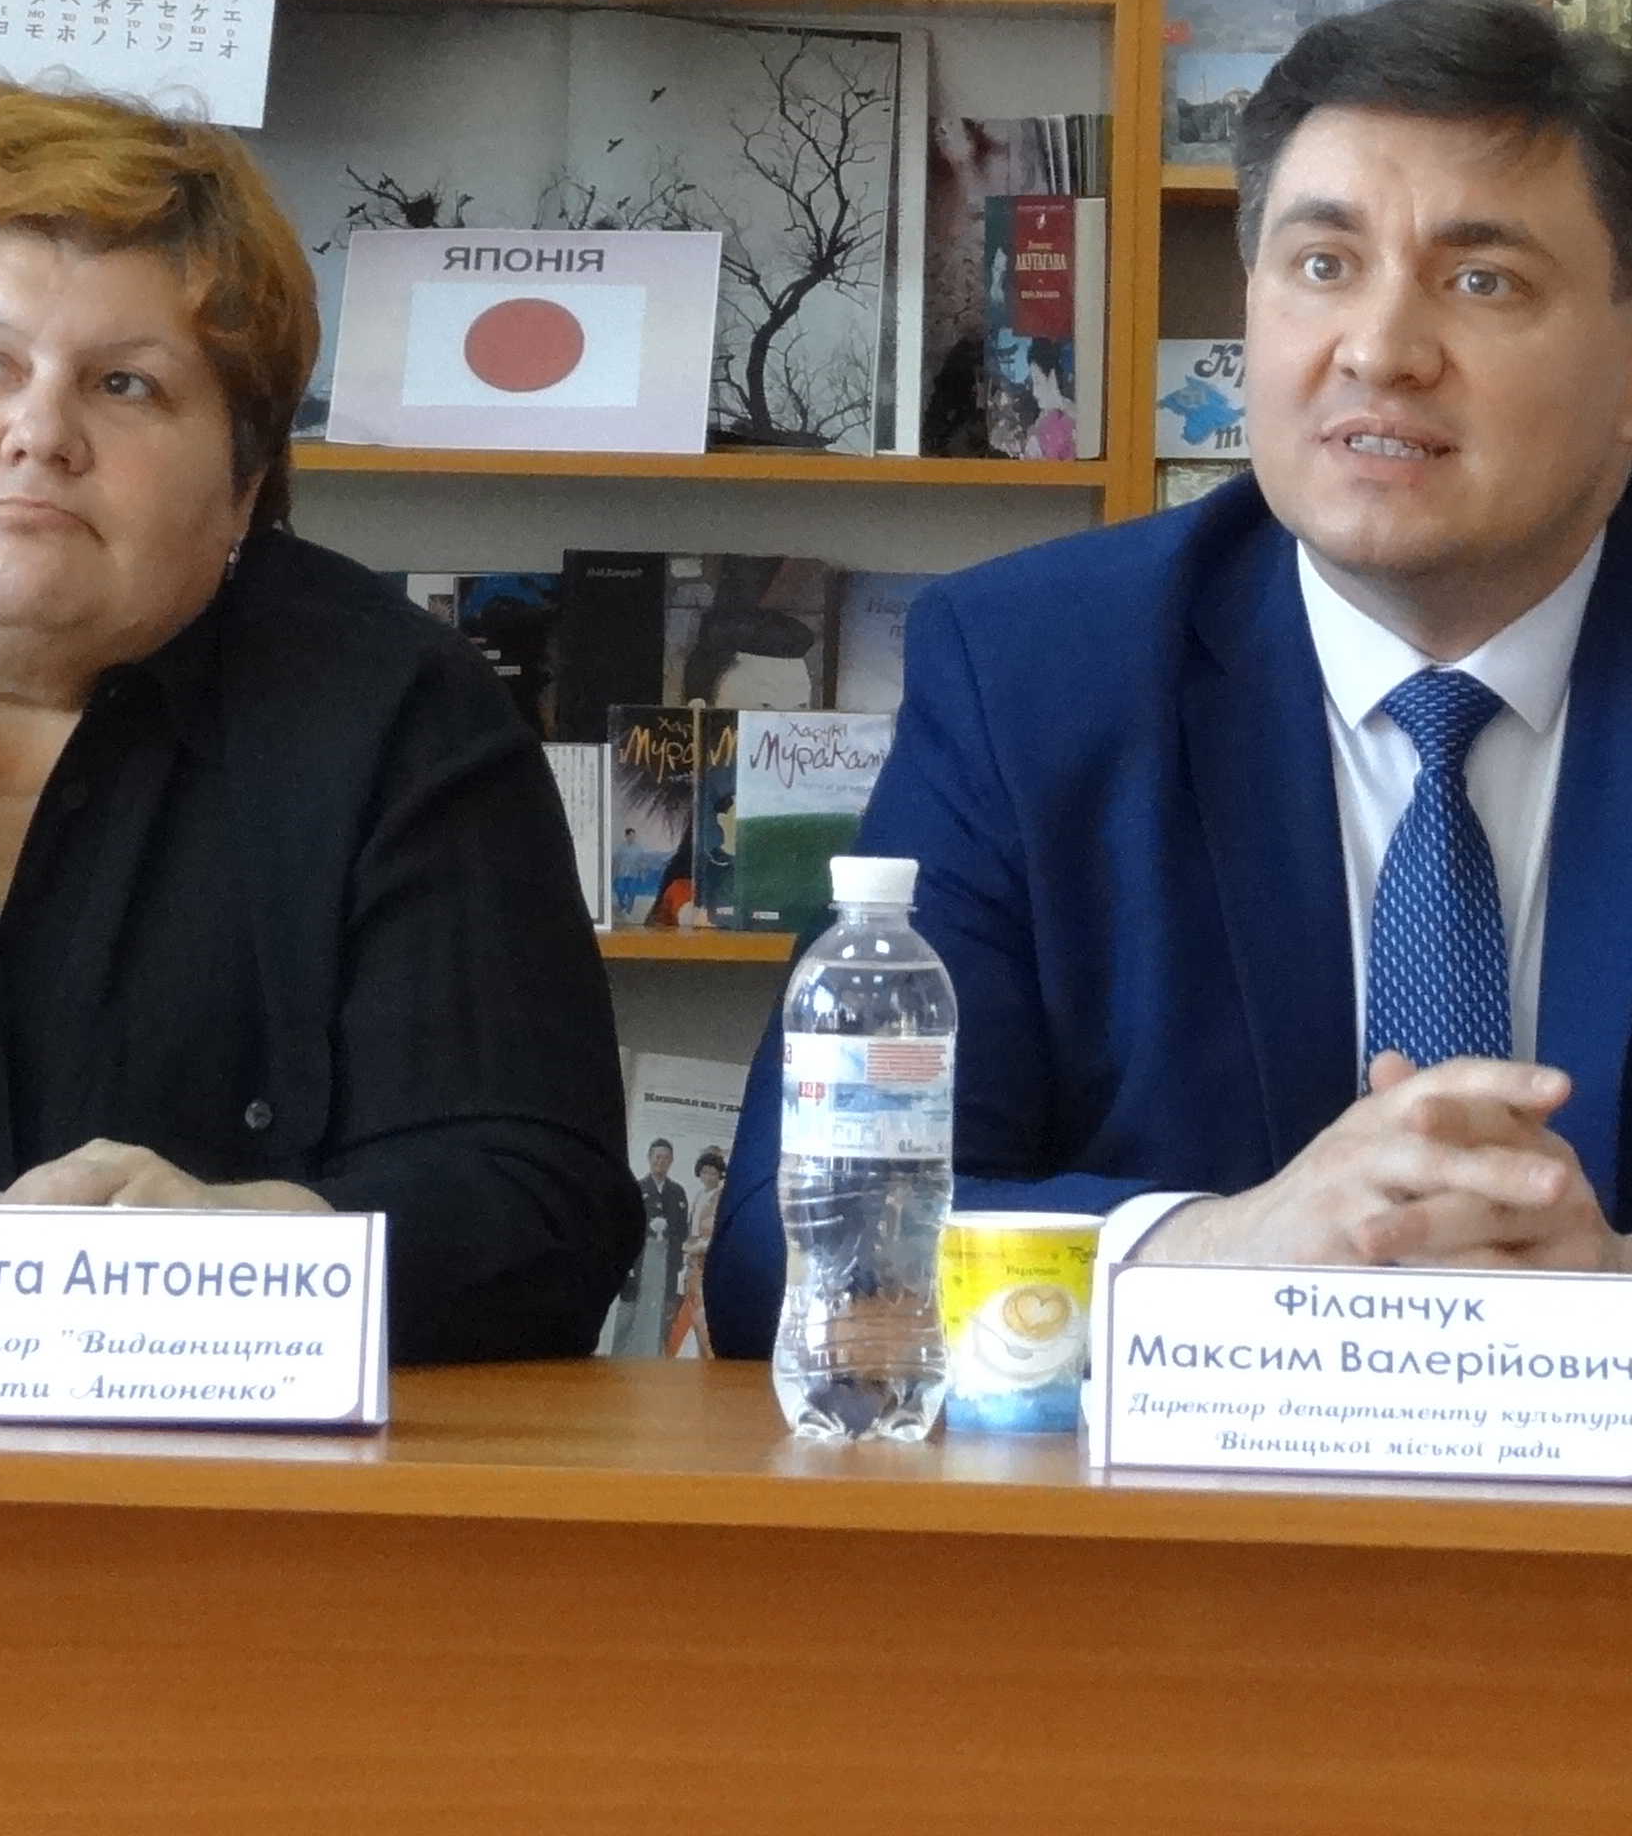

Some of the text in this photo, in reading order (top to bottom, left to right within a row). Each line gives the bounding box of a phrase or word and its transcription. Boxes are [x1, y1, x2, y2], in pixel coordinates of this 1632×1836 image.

[441, 245, 607, 274] ЯПОНІЯ
[63, 1248, 354, 1299] Антоненко
[1273, 1283, 1487, 1329] Філанчук
[59, 1327, 326, 1362] "Видавництва
[1127, 1334, 1323, 1374] Максим
[68, 1373, 296, 1404] Антоненко"
[1128, 1391, 1266, 1419] Директор
[1276, 1397, 1489, 1427] департаменту
[1214, 1430, 1563, 1464] Вінницької міської ради
